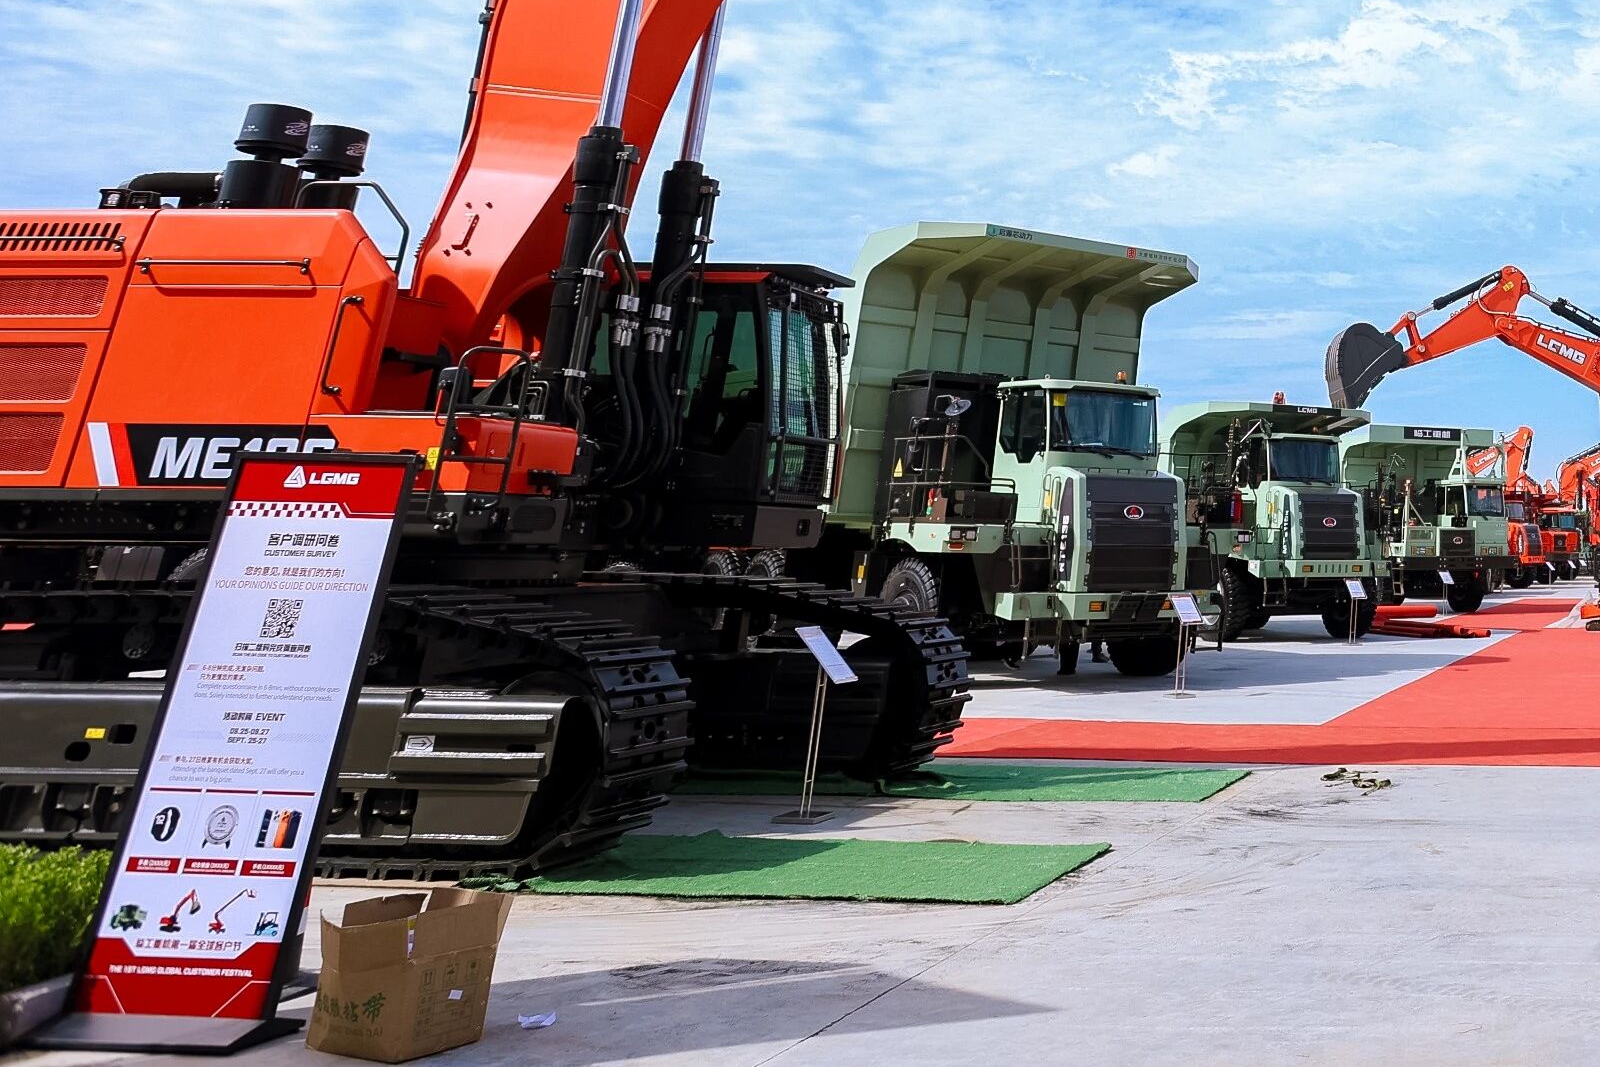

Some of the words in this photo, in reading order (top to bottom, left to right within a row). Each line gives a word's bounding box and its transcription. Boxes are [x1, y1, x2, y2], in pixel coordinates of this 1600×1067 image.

[1536, 334, 1587, 365] LGMG
[308, 472, 360, 485] LGMG
[267, 534, 340, 548] 客户调研问卷
[306, 550, 338, 558] SURVEY
[215, 580, 237, 589] YOUR
[238, 580, 277, 590] OPINIONS
[278, 581, 304, 590] GUIDE
[305, 582, 322, 591] OUR
[322, 582, 368, 592] DIRECTION
[255, 712, 286, 722] EVENT
[221, 968, 253, 977] FESTIVAL
